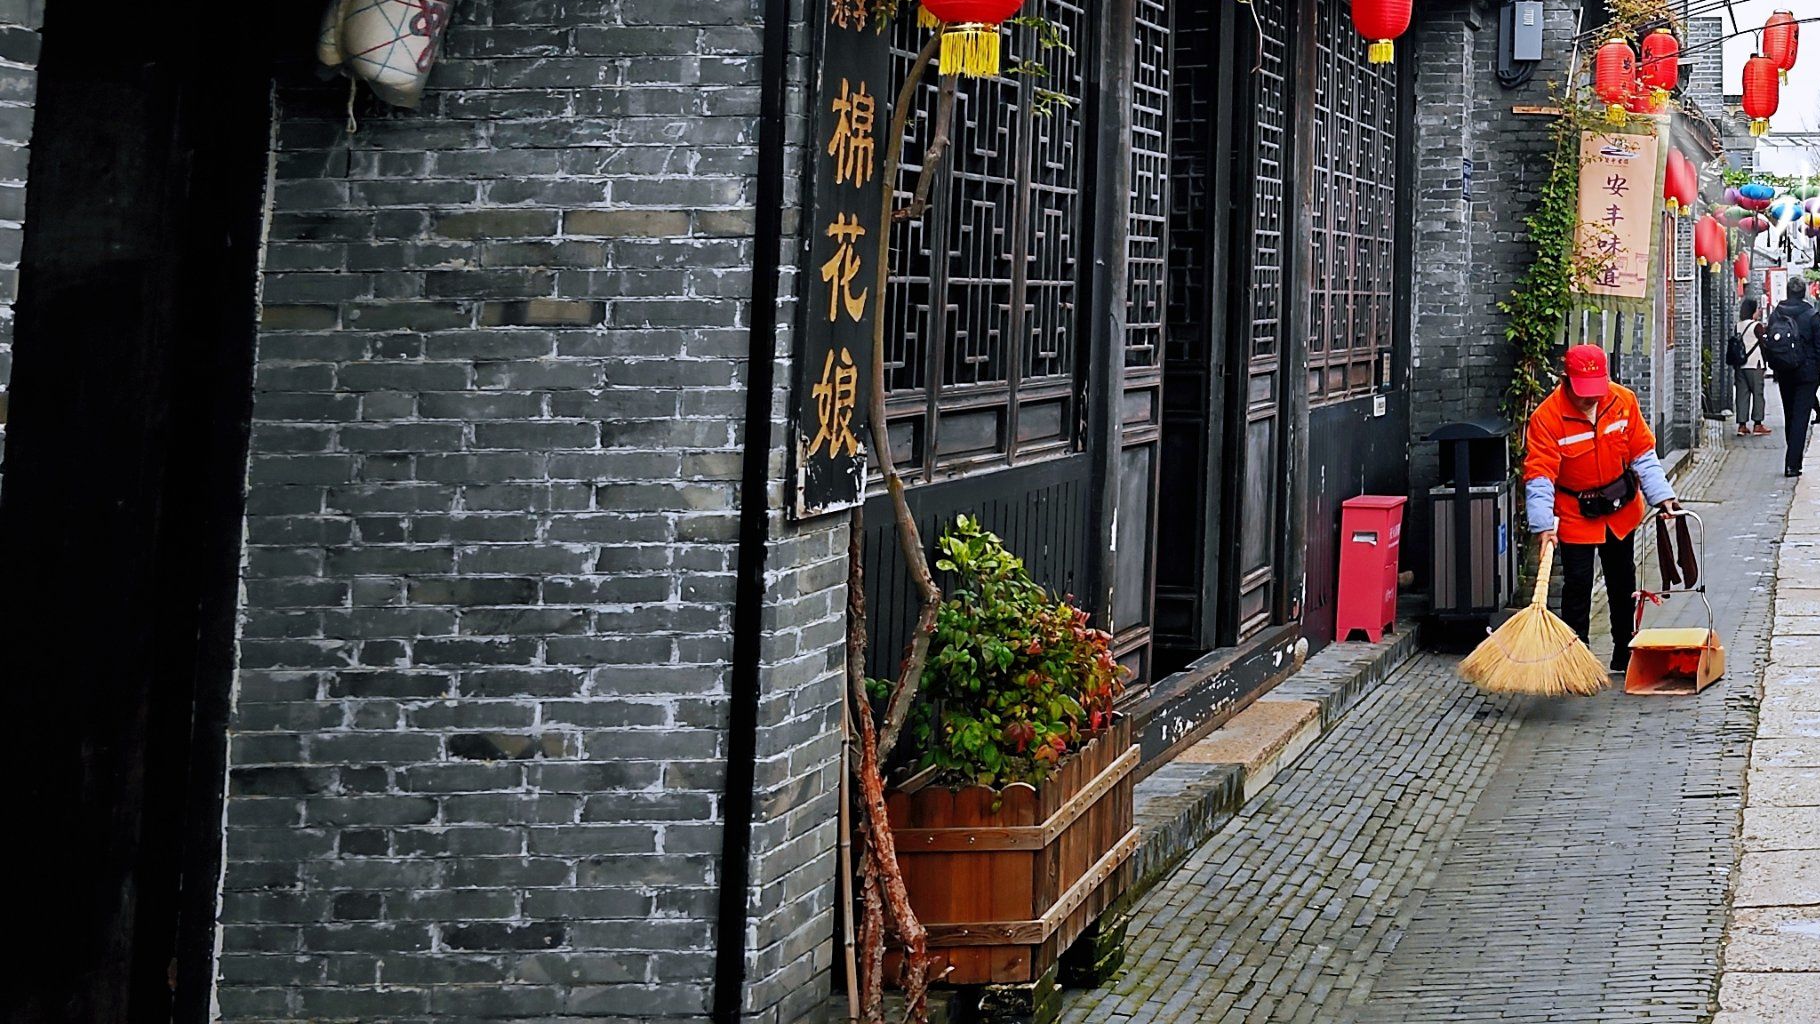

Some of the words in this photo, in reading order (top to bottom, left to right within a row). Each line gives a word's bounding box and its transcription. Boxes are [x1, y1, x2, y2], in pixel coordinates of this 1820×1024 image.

[807, 77, 875, 460] 棉花娘
[1594, 172, 1630, 289] 安丰味道
